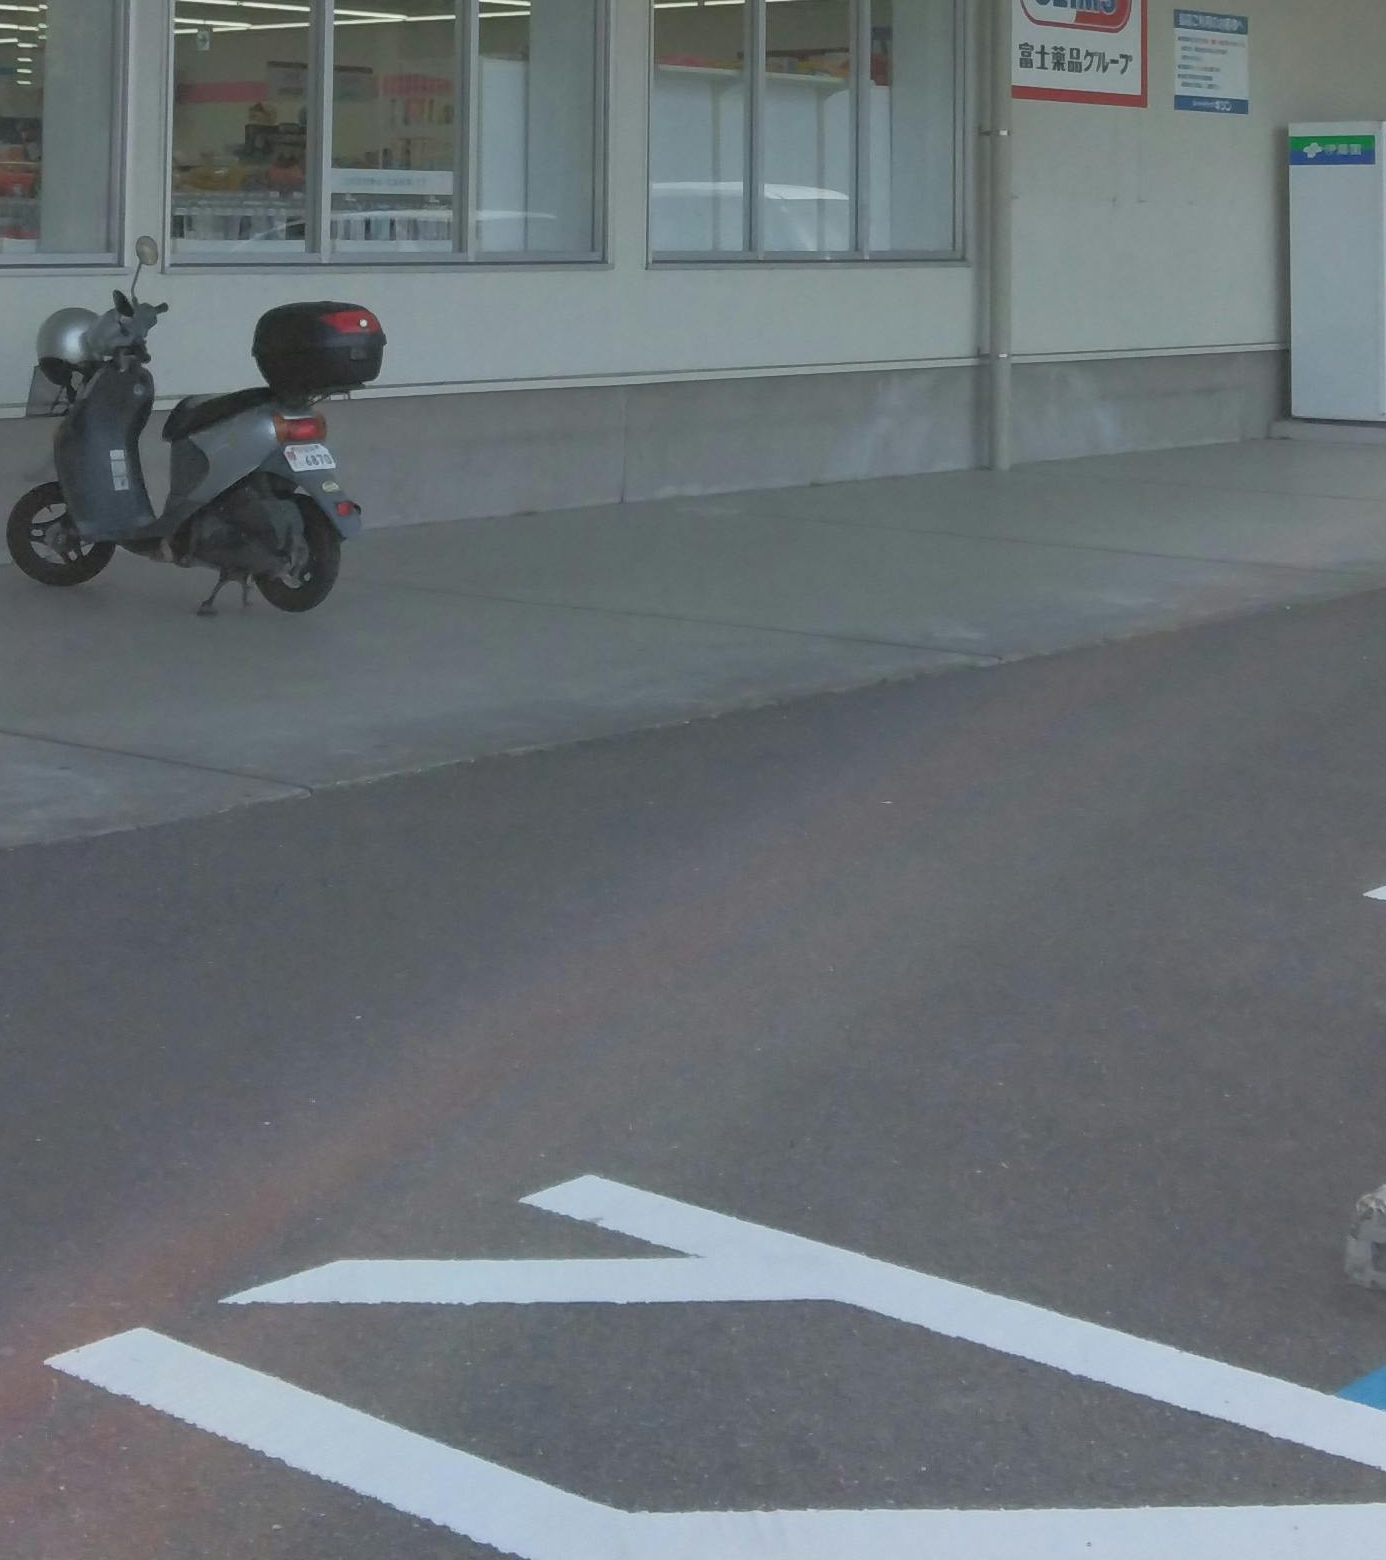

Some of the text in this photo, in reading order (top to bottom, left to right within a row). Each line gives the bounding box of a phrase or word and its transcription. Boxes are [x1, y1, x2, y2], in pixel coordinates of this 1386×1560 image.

[1018, 42, 1133, 74] 富士薬品グループ
